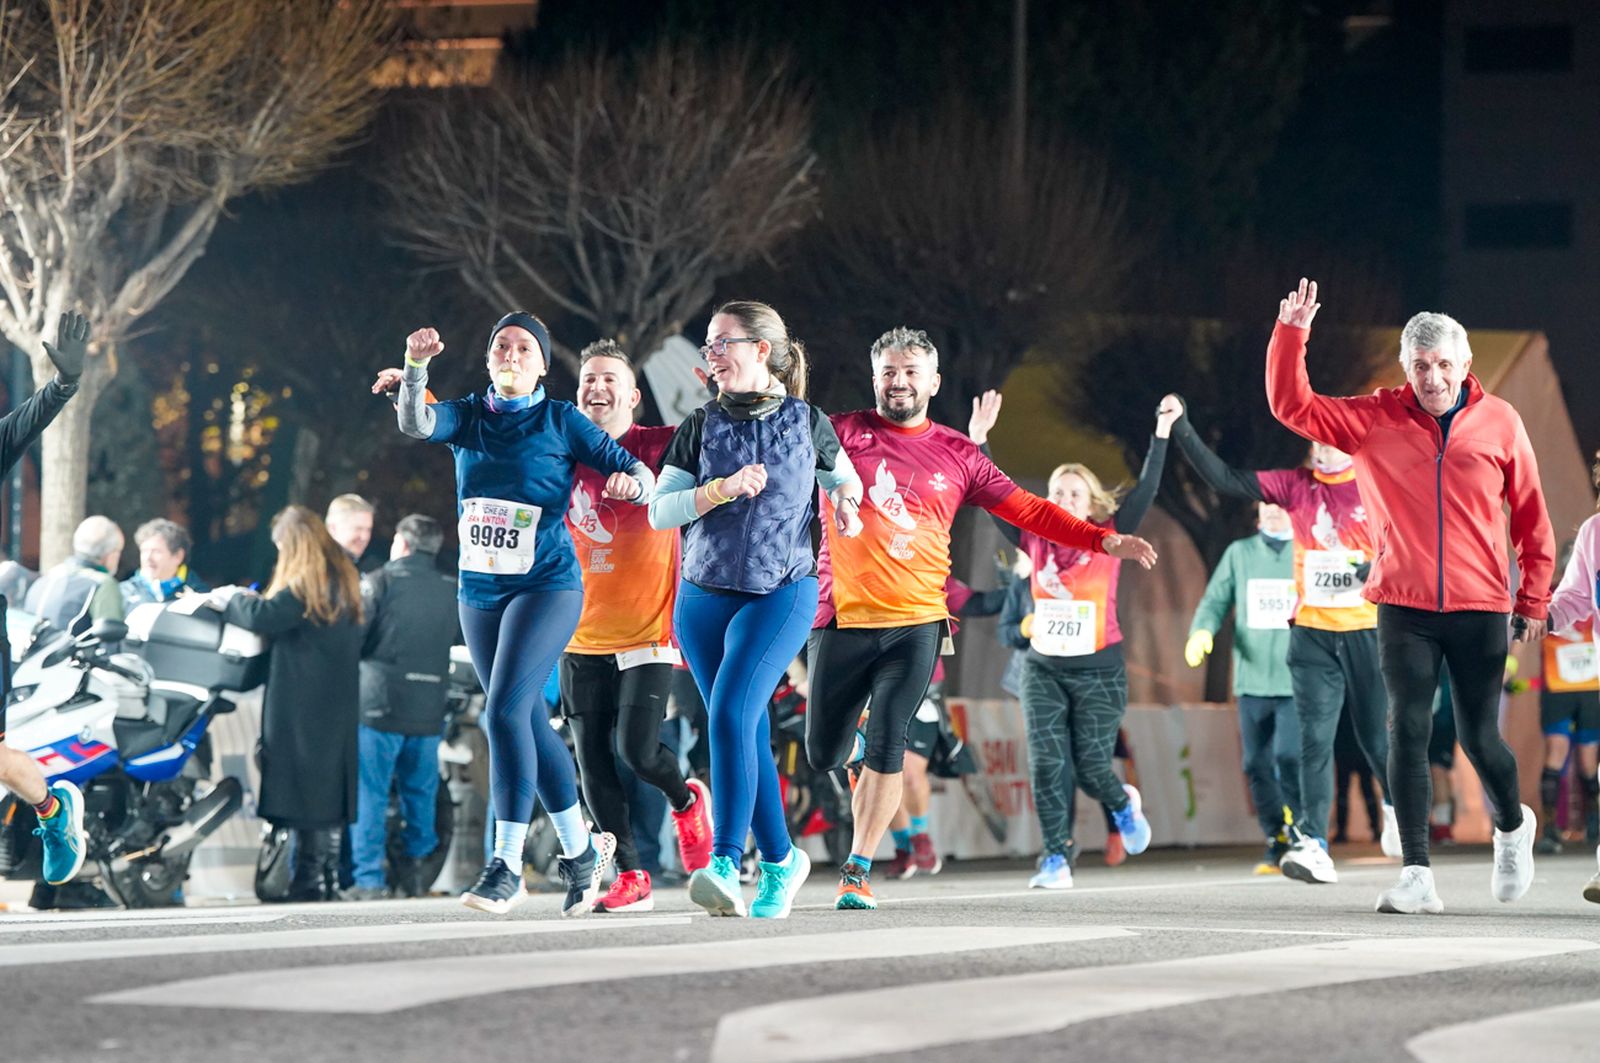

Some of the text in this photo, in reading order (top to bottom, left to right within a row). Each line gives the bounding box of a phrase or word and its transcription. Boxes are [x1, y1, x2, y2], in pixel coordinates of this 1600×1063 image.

[882, 497, 903, 517] 43
[579, 514, 597, 533] 43
[470, 524, 520, 549] 9983
[1314, 571, 1353, 588] 2266
[1047, 620, 1082, 636] 2267
